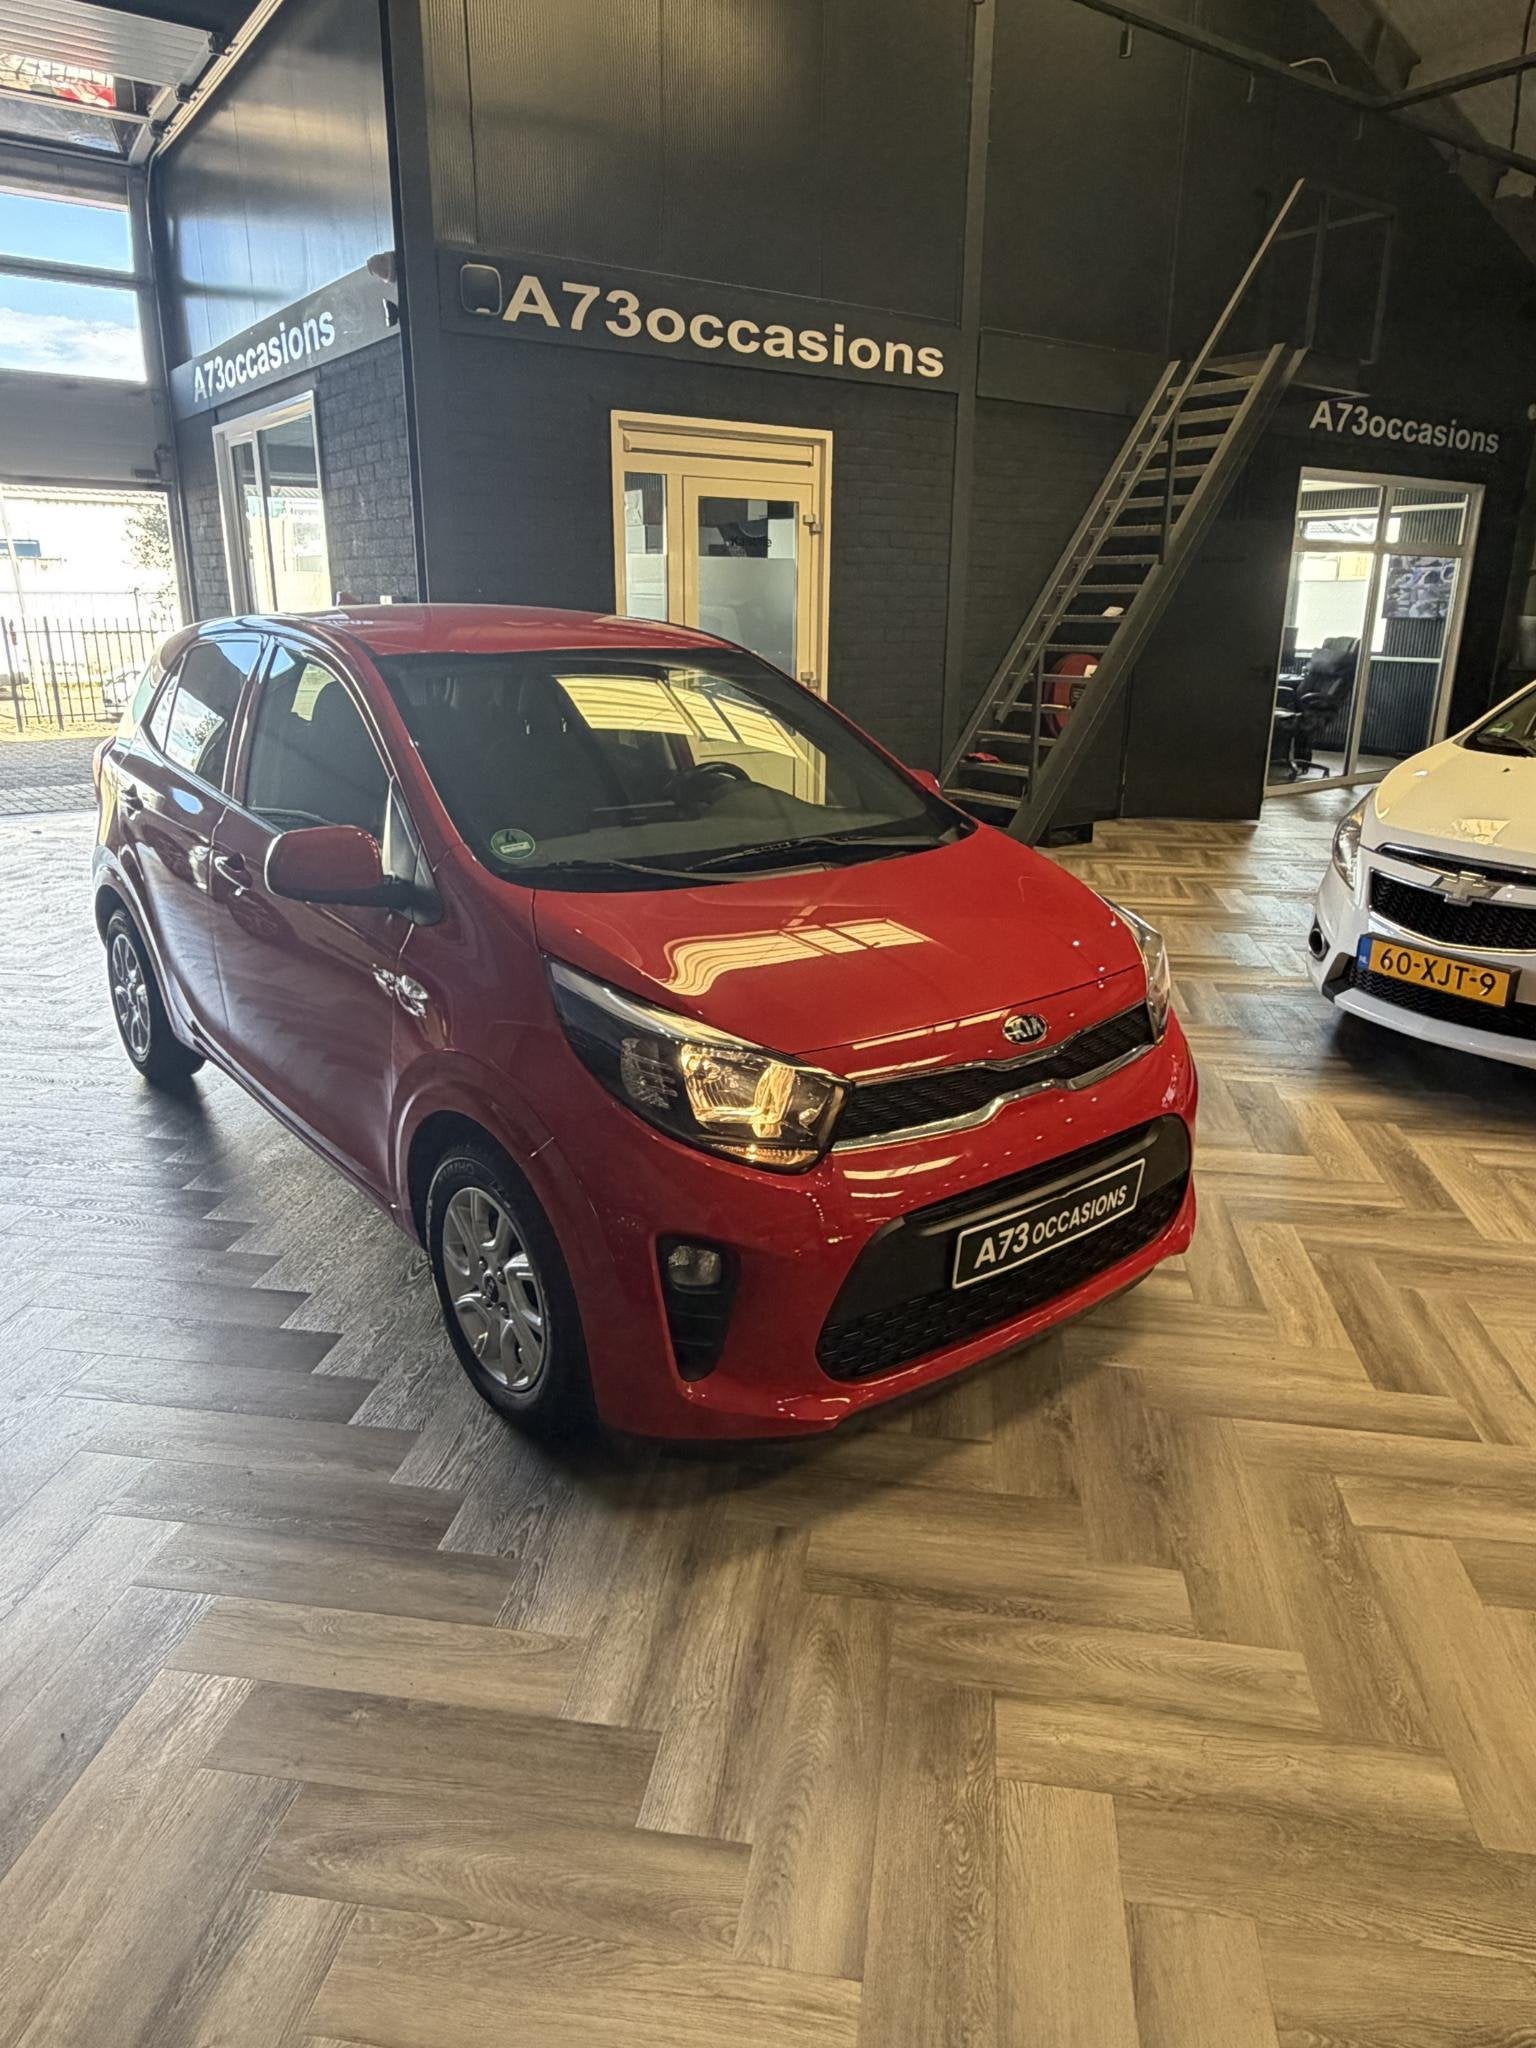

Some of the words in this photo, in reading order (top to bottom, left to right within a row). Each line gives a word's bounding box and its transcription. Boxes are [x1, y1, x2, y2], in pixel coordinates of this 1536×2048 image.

[193, 309, 336, 403] A73occasions
[502, 274, 945, 379] A73occasions
[1309, 401, 1499, 454] A73occasions
[1379, 948, 1497, 997] 60-XJT-9
[1007, 1016, 1044, 1041] KIA
[973, 1221, 1029, 1269] A73
[1032, 1185, 1128, 1245] OCCASIONS
